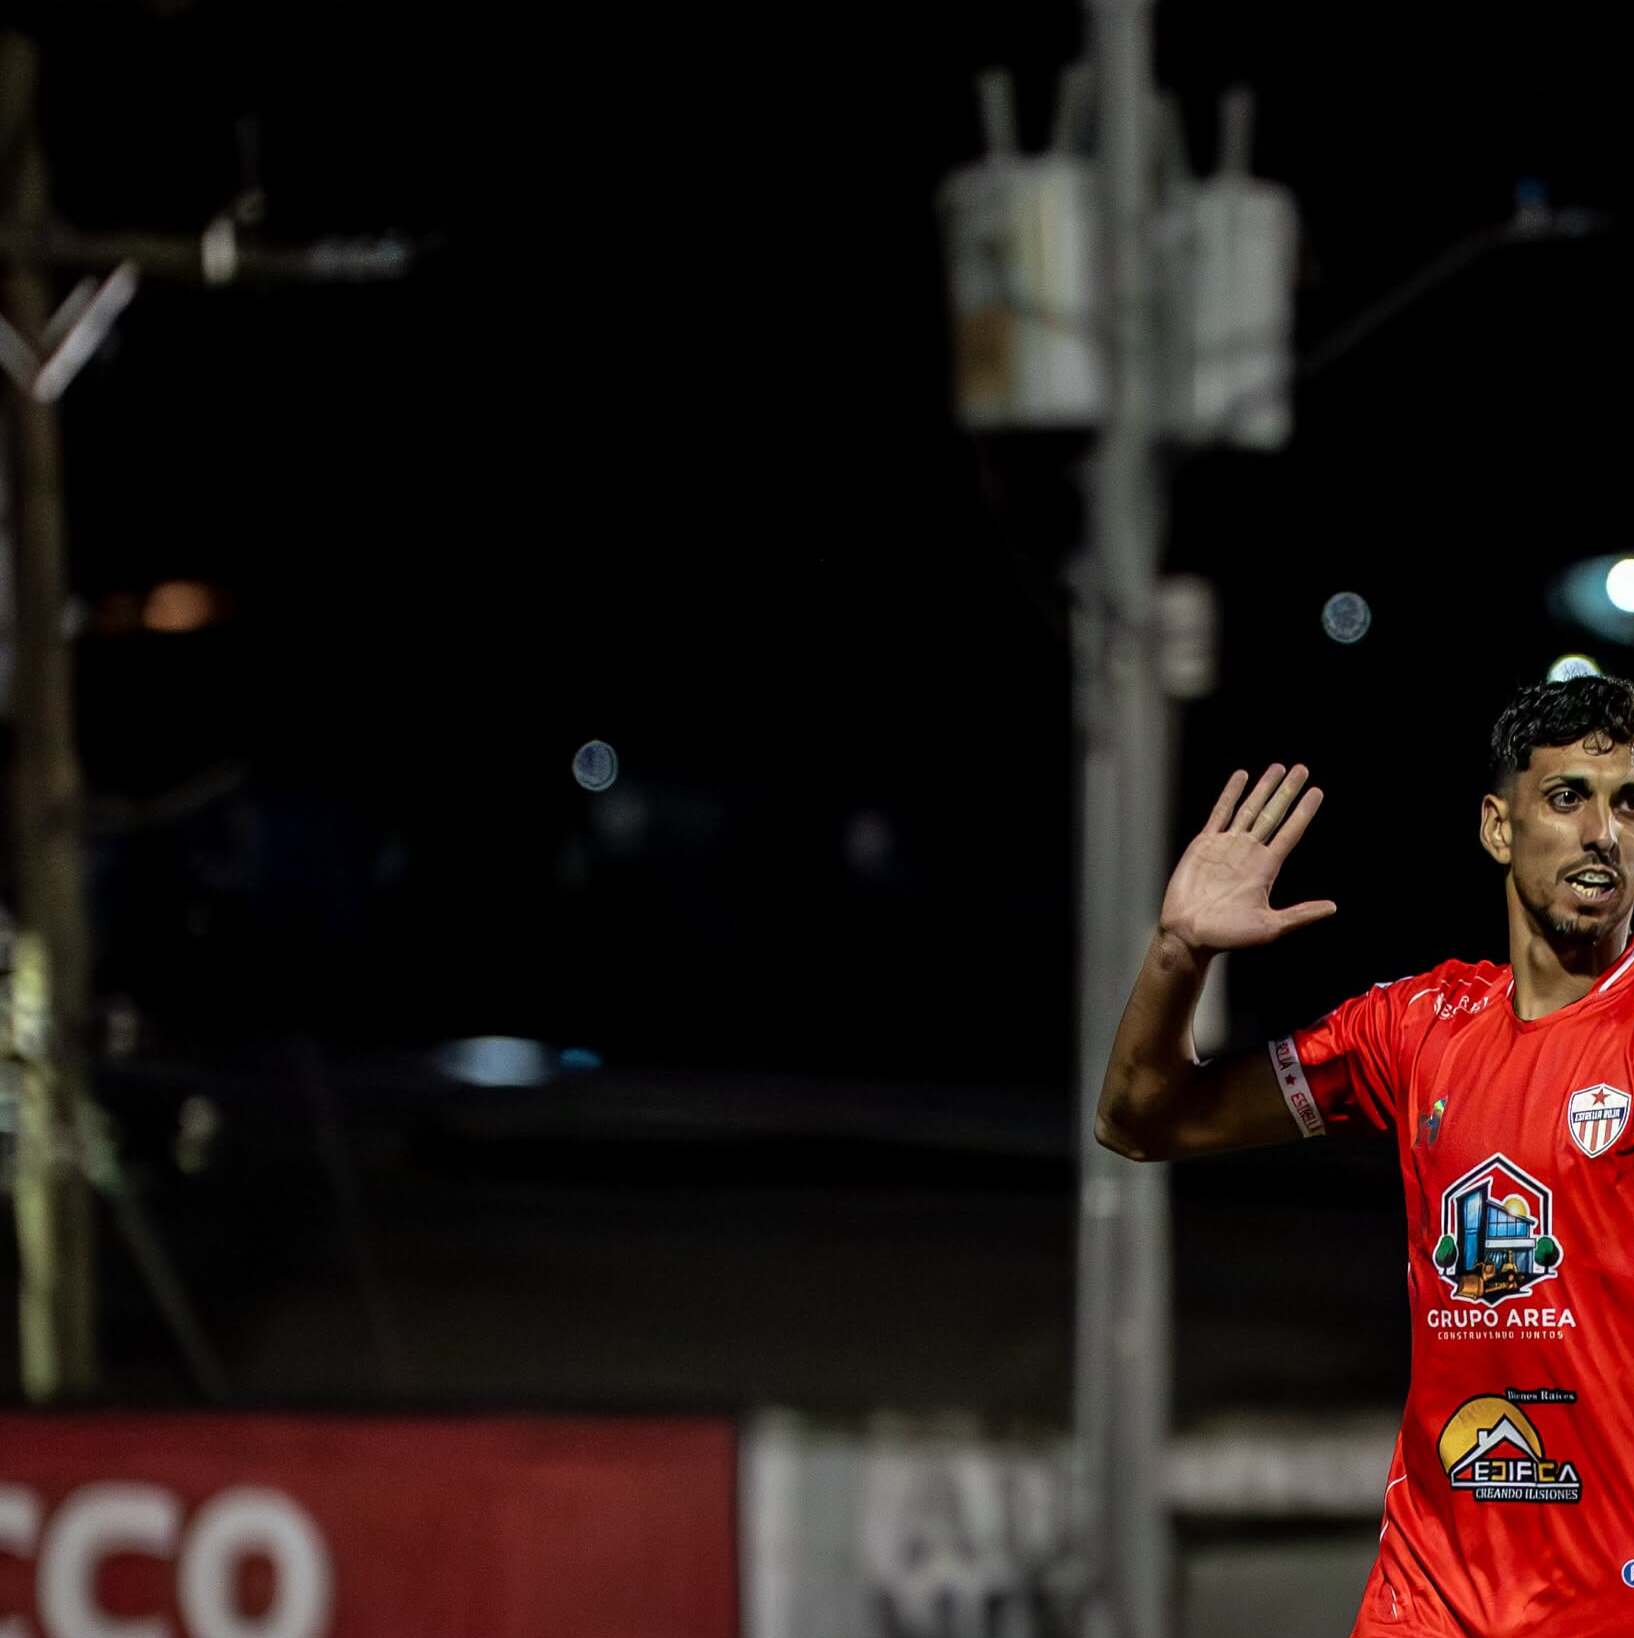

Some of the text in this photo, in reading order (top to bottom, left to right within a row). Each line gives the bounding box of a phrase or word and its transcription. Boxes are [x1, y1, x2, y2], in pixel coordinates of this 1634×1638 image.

[1427, 1308, 1577, 1328] GRUPO AREA
[1520, 1331, 1564, 1340] JUNTOS
[1475, 1487, 1523, 1500] CREANDO
